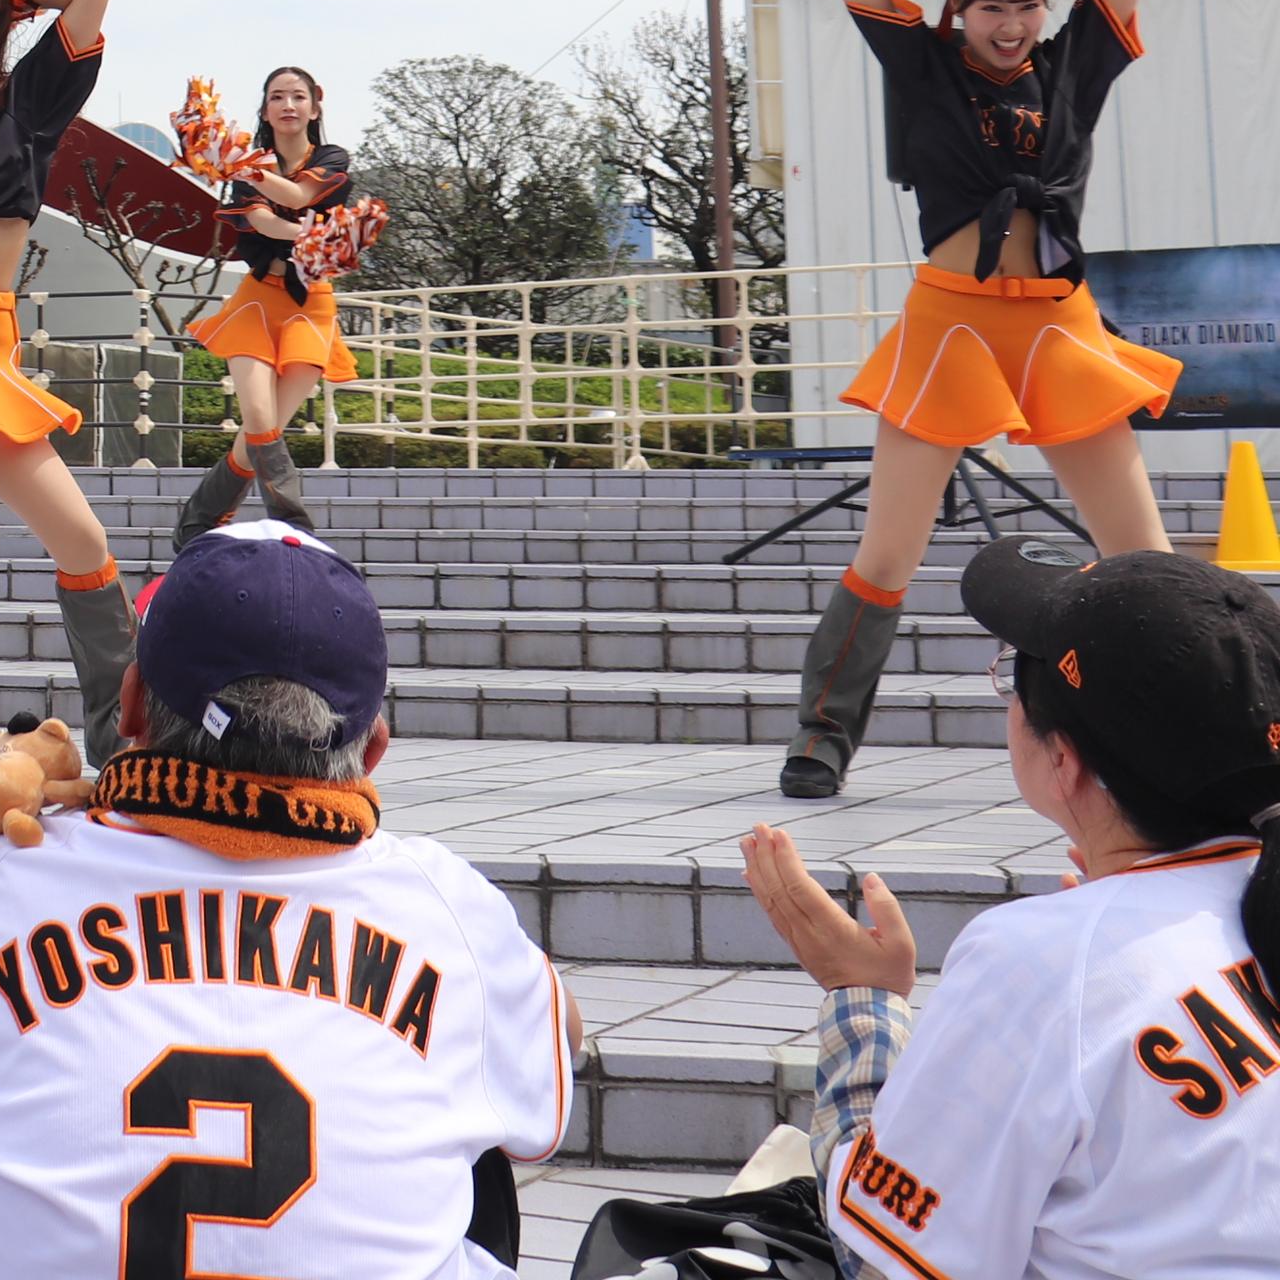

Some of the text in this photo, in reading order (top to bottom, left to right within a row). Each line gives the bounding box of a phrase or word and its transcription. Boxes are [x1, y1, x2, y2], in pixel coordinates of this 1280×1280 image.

[1142, 322, 1277, 346] BLACK DIAMOND
[120, 1043, 317, 1280] 2
